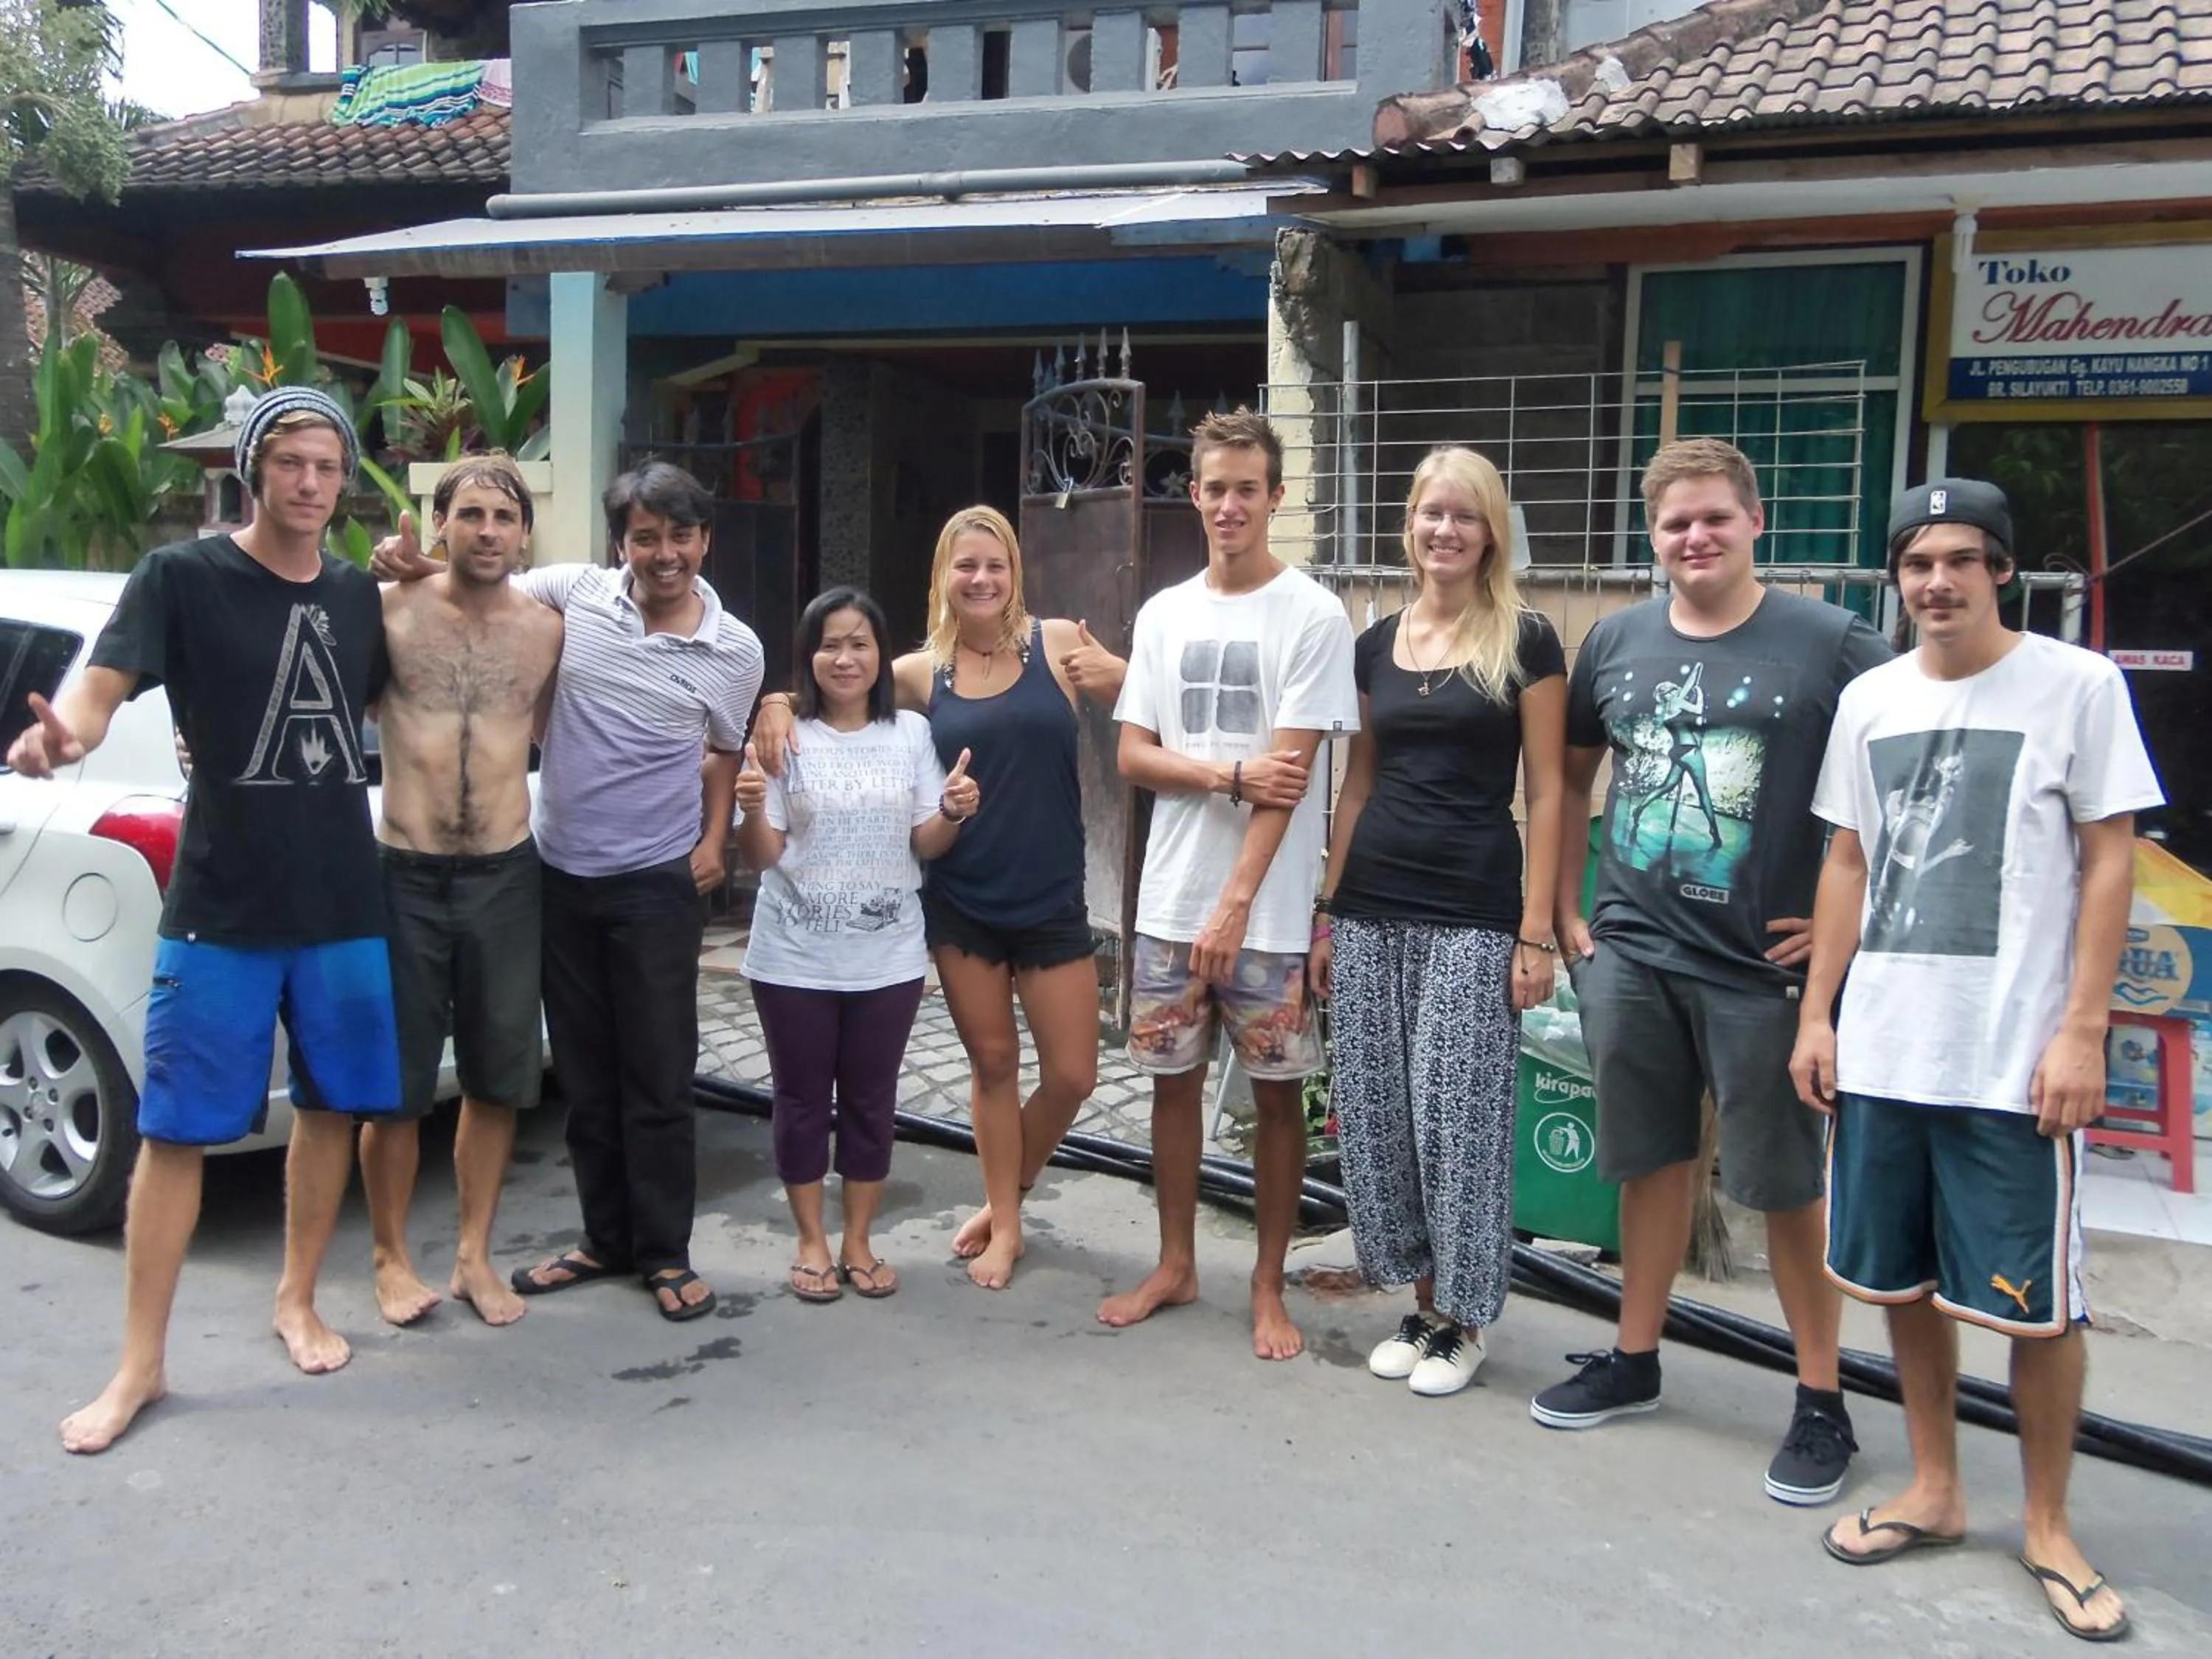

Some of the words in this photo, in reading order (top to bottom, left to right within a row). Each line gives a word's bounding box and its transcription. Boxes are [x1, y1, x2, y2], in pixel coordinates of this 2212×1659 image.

[1978, 259, 2070, 285] Toko
[1972, 291, 2212, 344] Mahendra
[2091, 357, 2124, 374] KAYU
[844, 779, 863, 791] BY
[807, 891, 860, 905] MORE
